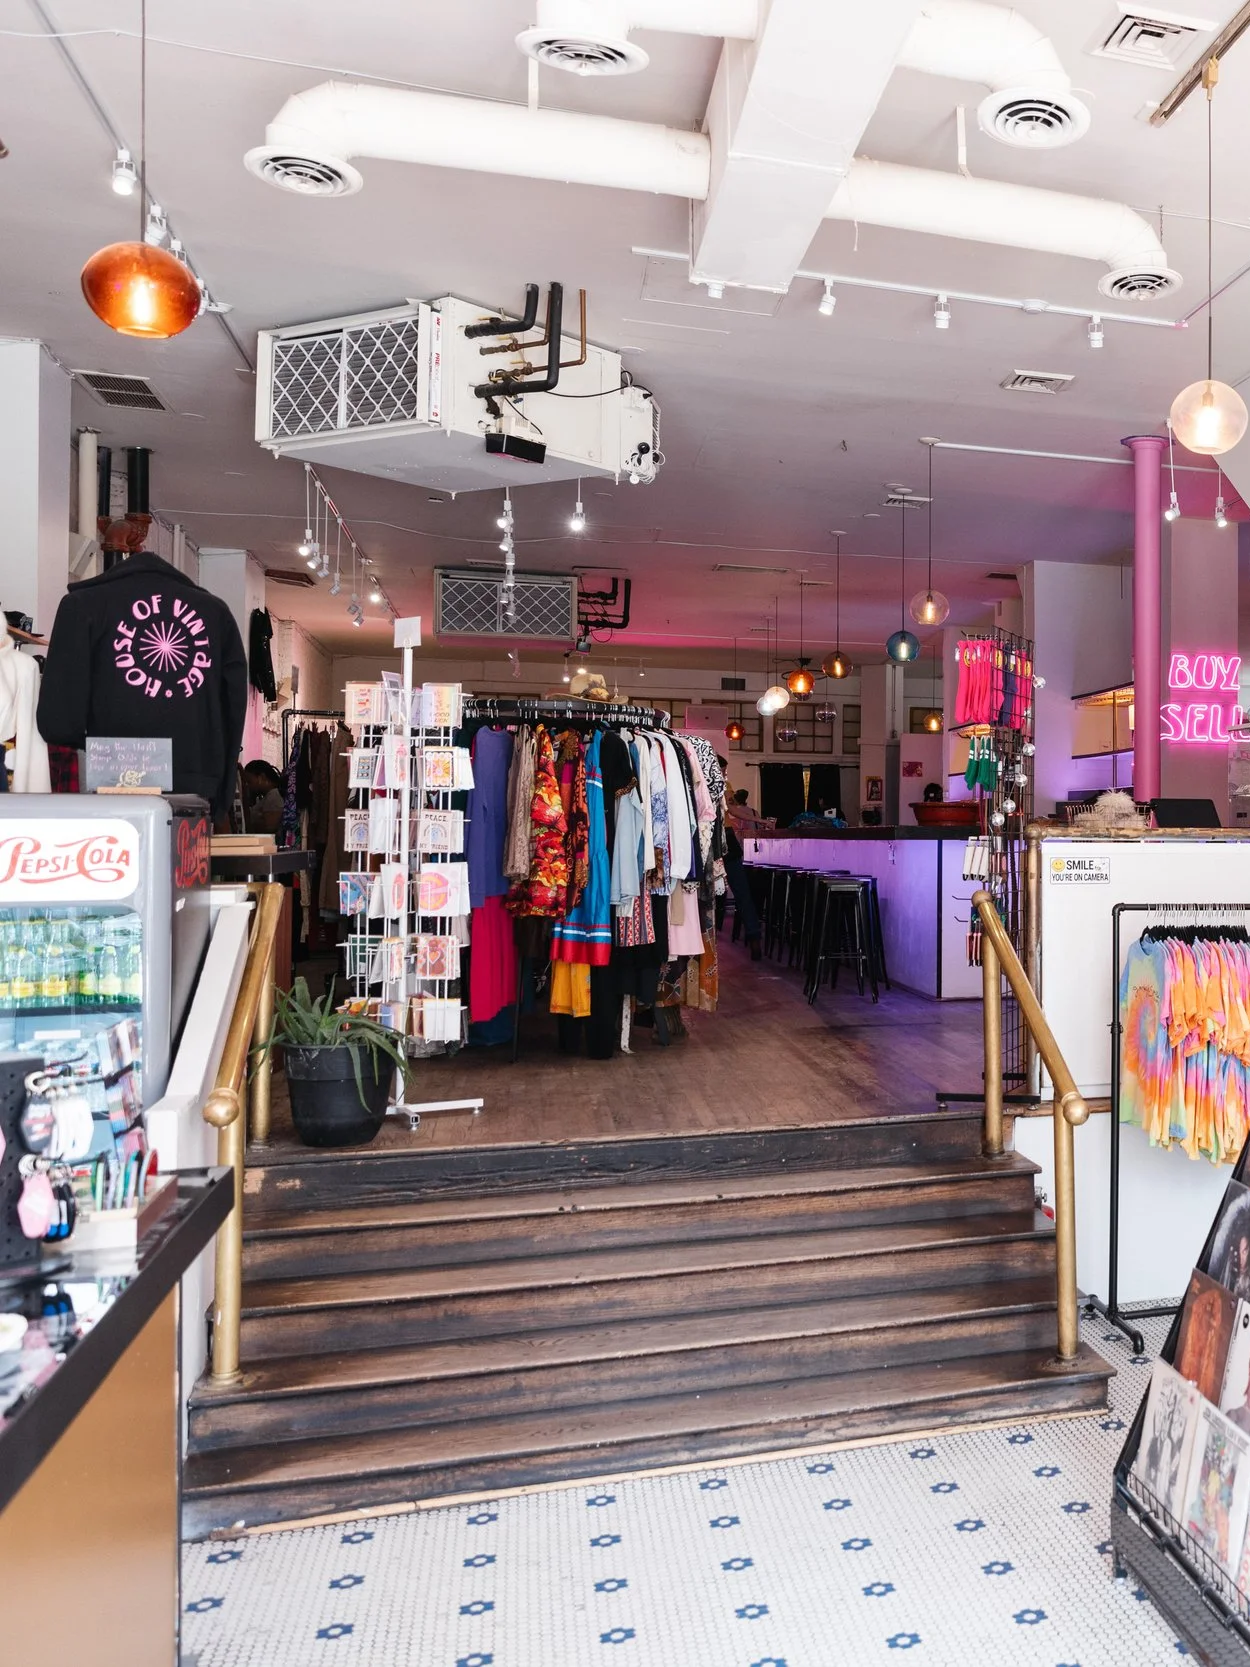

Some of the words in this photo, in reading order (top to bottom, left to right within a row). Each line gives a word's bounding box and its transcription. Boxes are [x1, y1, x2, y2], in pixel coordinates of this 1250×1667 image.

[132, 594, 162, 620] OF
[173, 599, 212, 698] VINTAGE
[113, 620, 163, 698] HOUSE
[1168, 655, 1242, 690] BUY
[350, 813, 370, 821] PEAC
[424, 813, 447, 822] PEACE
[1066, 860, 1095, 870] SMILE
[1052, 873, 1073, 882] YOU'RE
[1073, 873, 1083, 882] ON
[1084, 873, 1109, 881] CAMERA
